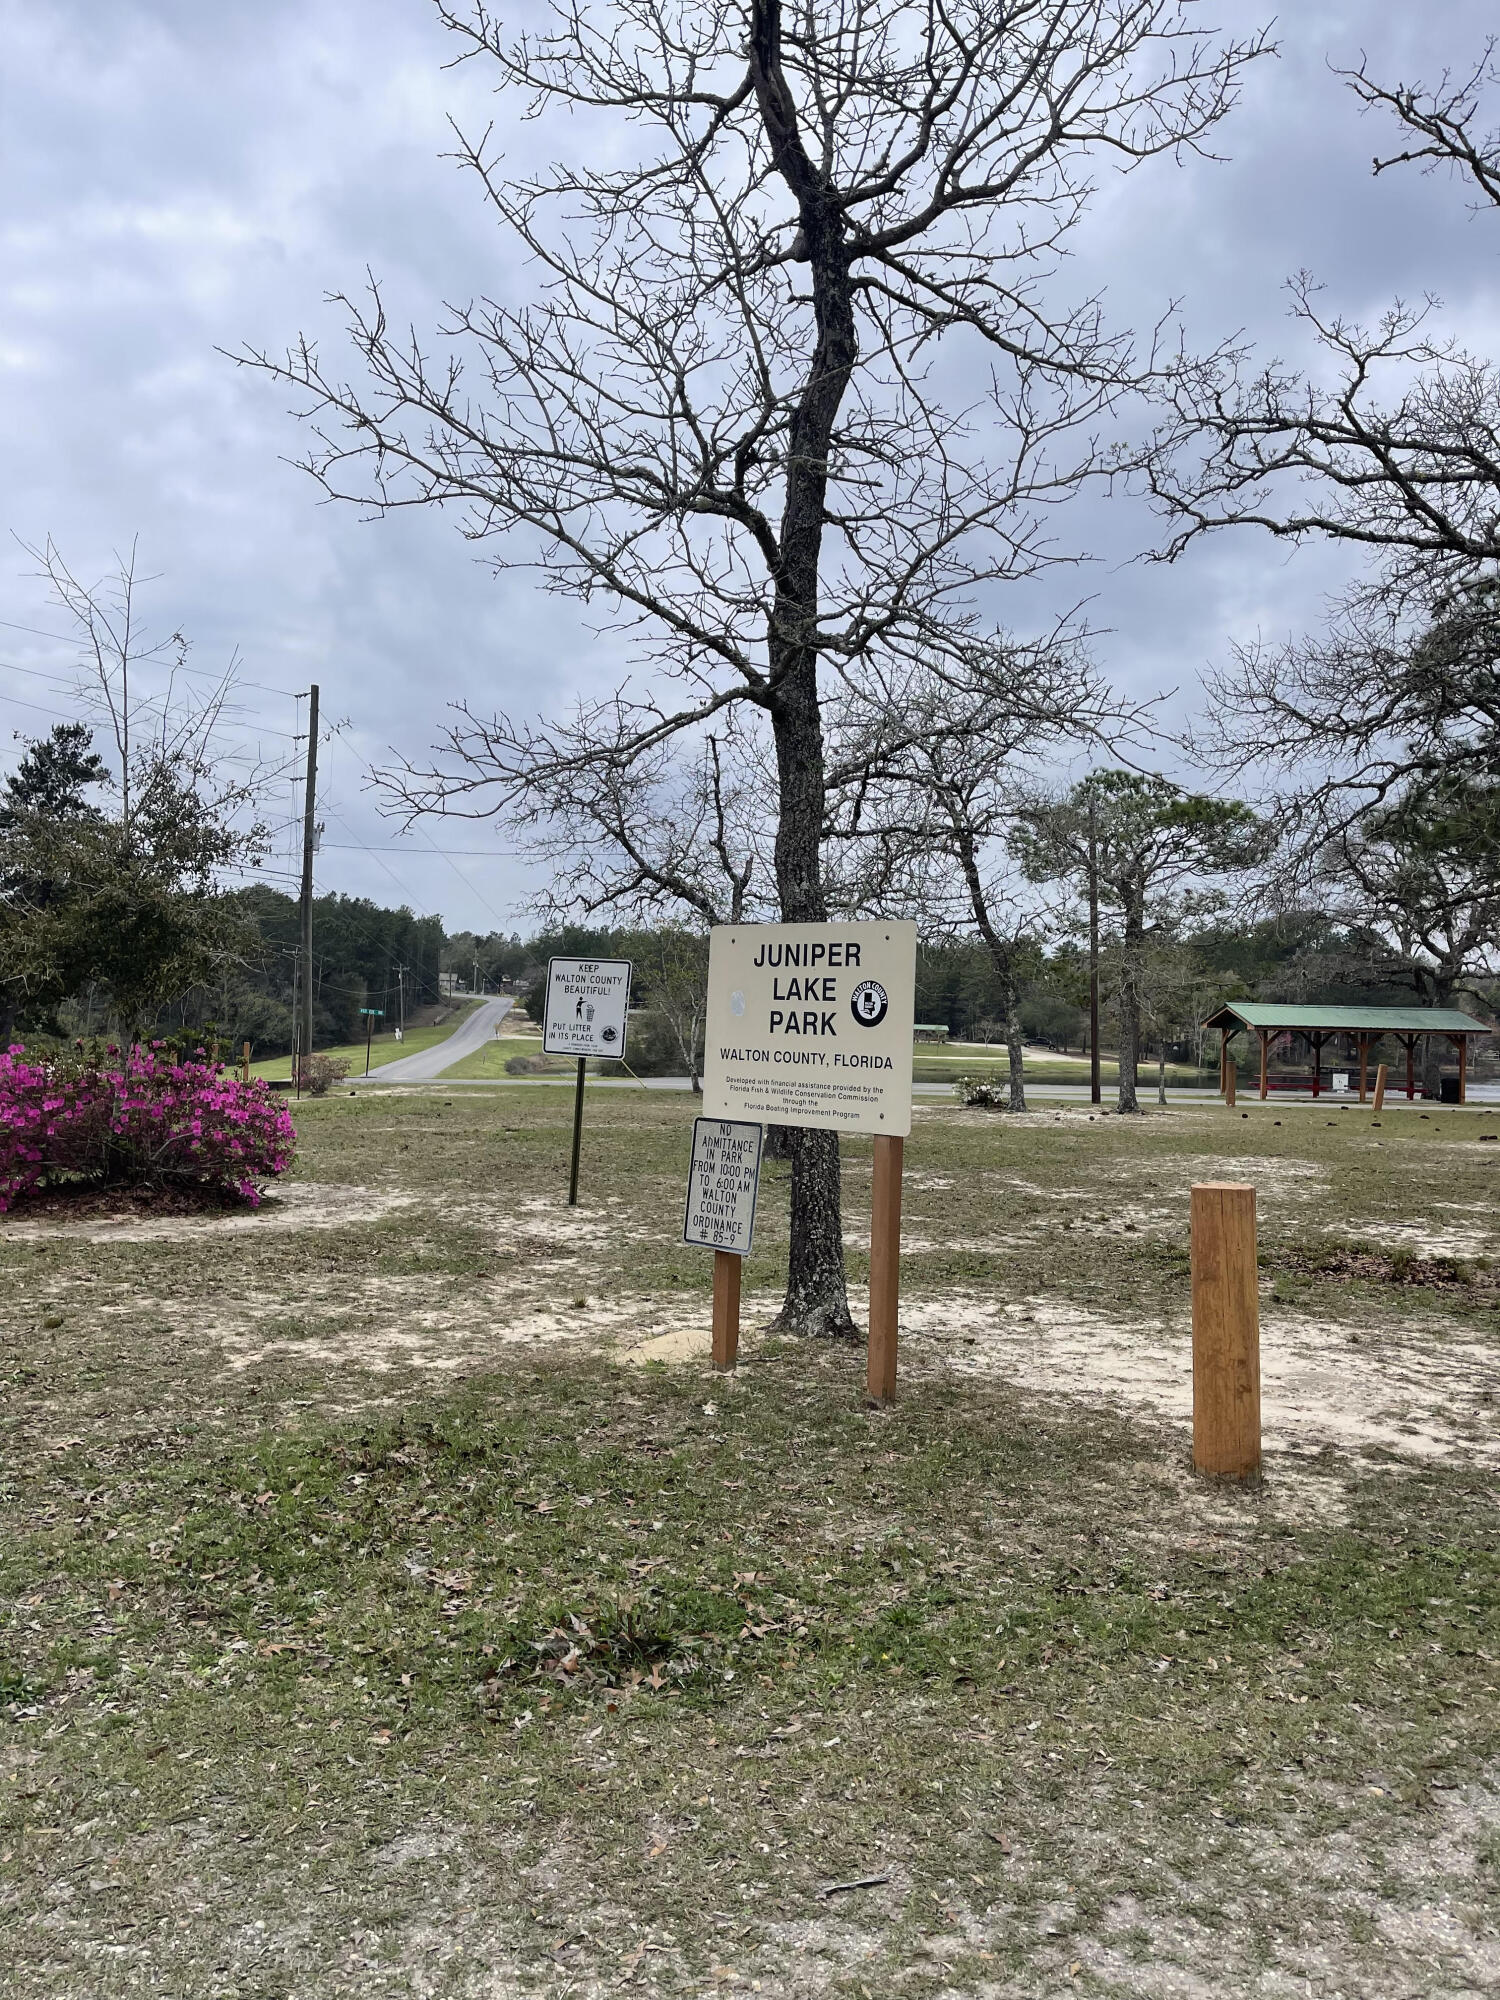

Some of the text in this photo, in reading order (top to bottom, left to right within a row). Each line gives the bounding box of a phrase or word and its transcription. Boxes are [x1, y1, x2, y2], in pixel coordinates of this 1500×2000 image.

[754, 943, 861, 967] JUNIPER
[579, 964, 600, 973] KEEP
[555, 974, 623, 985] WALTON COUNTY
[564, 985, 611, 995] BEAUTIFUL!
[773, 977, 837, 1001] LAKE
[852, 982, 887, 1004] WALTON COUNTY
[552, 1023, 591, 1032] PUT LITTER
[769, 1011, 837, 1036] PARK
[558, 1032, 569, 1040] ITS
[572, 1034, 594, 1042] PLACE
[720, 1048, 893, 1069] WALTON COUNTY, FLORIDA
[726, 1076, 756, 1086] Developed
[771, 1079, 797, 1087] financial
[798, 1082, 831, 1090] assistance
[833, 1084, 861, 1093] provided
[863, 1086, 872, 1094] by
[771, 1088, 794, 1096] Wildlife
[795, 1089, 836, 1099] Conservation
[838, 1093, 879, 1103] Commission
[783, 1098, 807, 1106] through
[744, 1102, 860, 1119] Florida Boating Improvement Program
[720, 1124, 732, 1136] NO
[702, 1136, 754, 1153] ADMITTANCE
[706, 1149, 743, 1164] IN PARK
[693, 1160, 756, 1180] FROM 10:00 PM
[699, 1174, 750, 1193] TO 6:00 AM
[702, 1187, 737, 1204] WALTON
[700, 1201, 736, 1218] COUNTY
[693, 1214, 743, 1235] ORDINANCE
